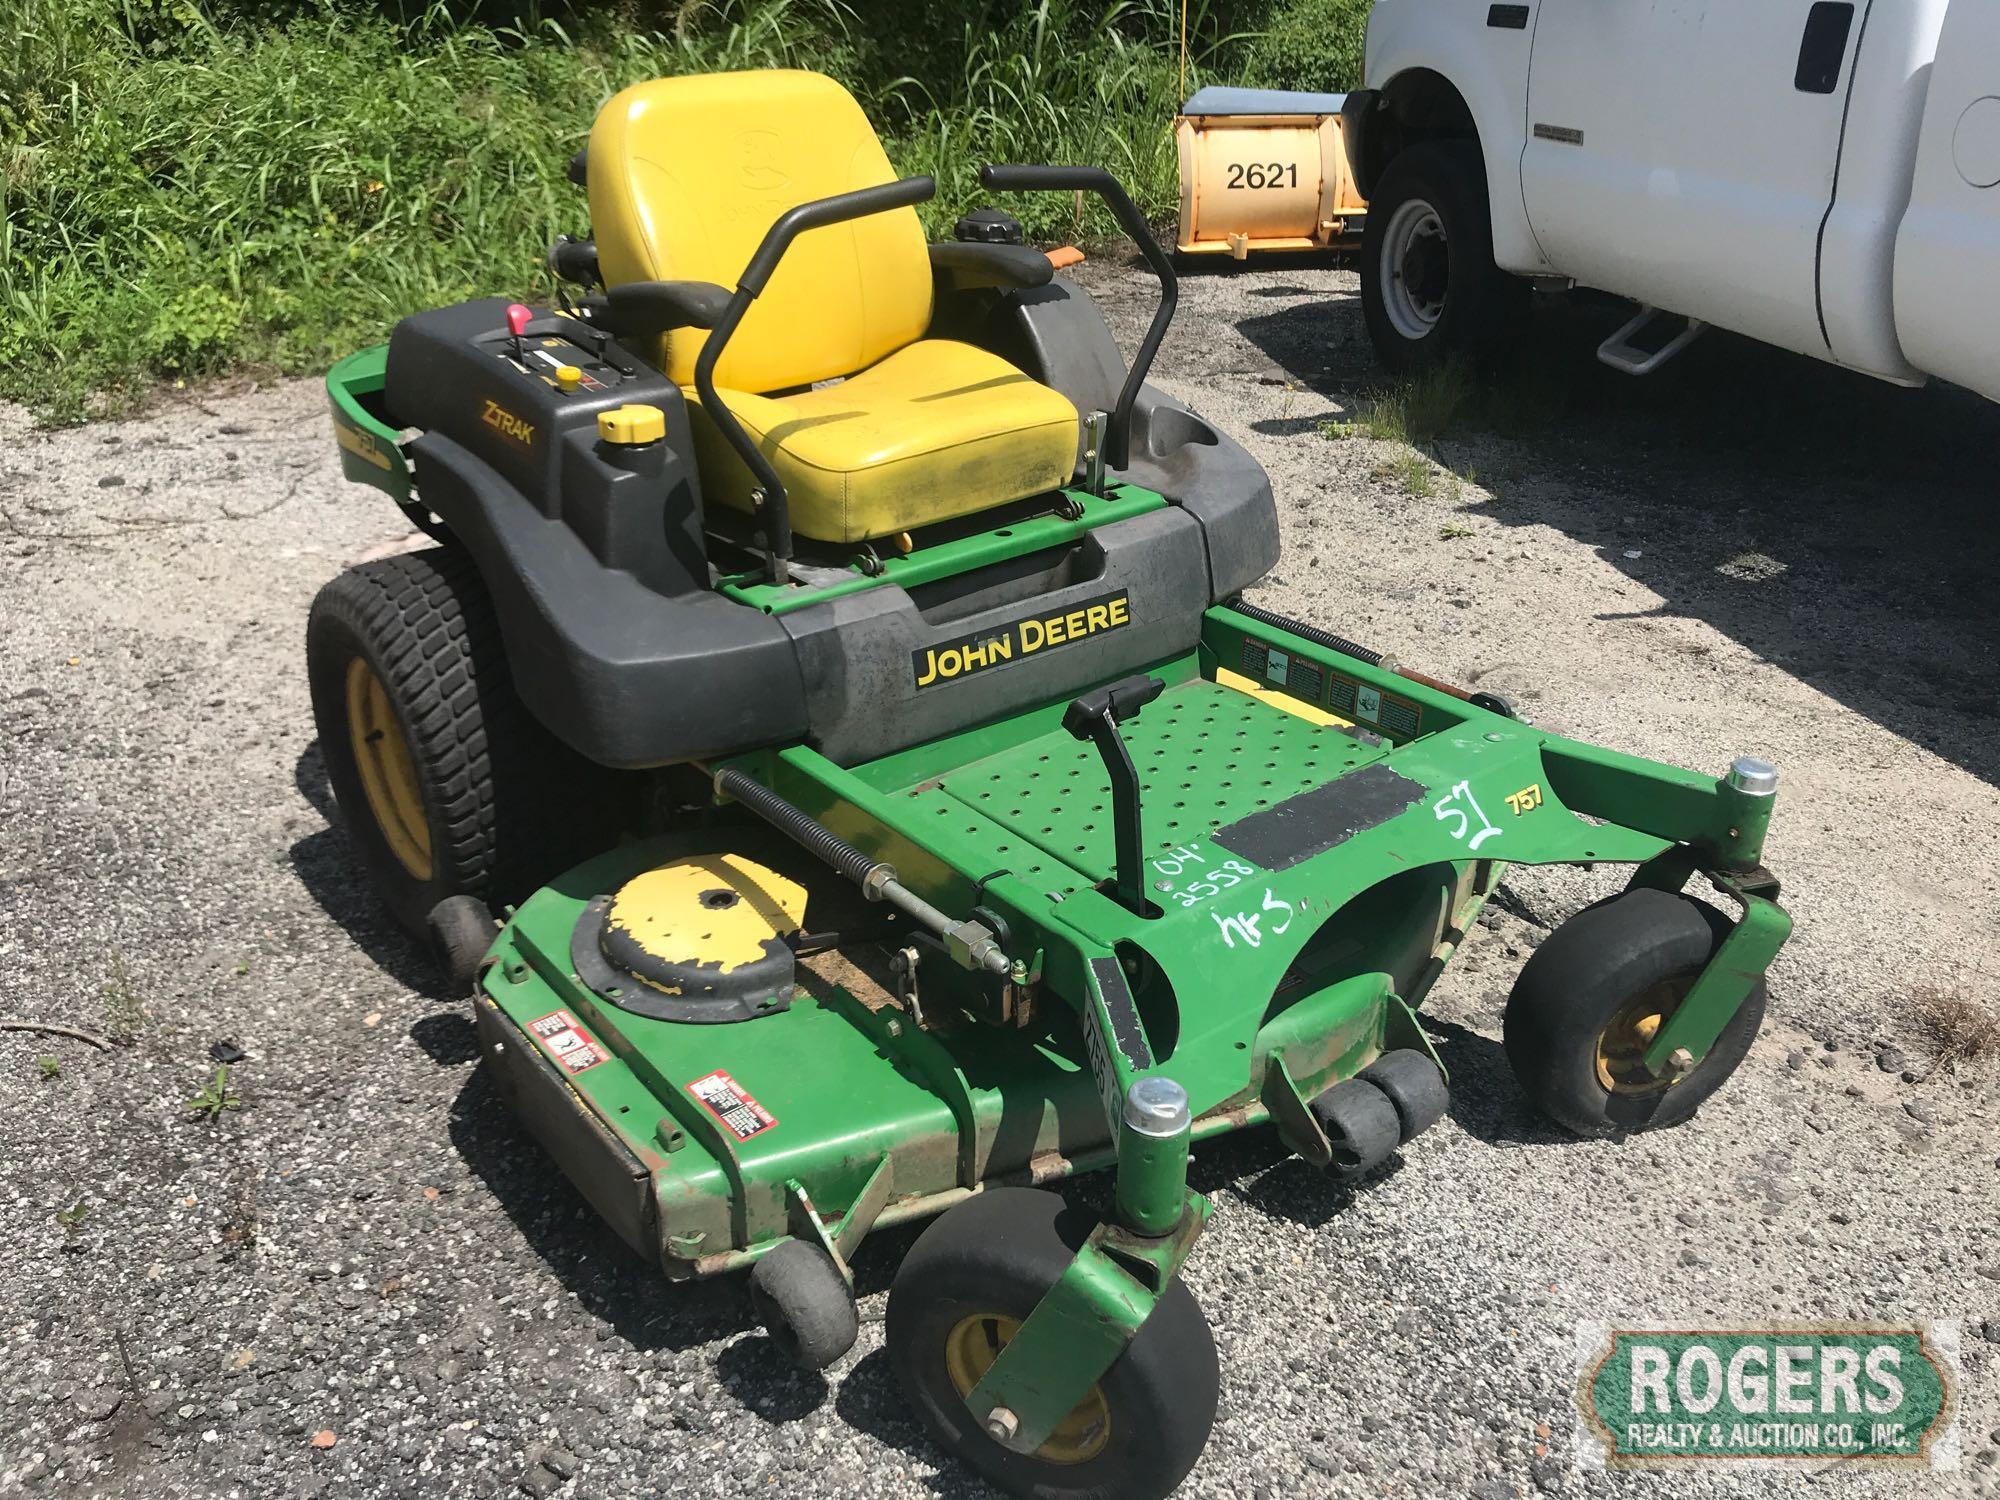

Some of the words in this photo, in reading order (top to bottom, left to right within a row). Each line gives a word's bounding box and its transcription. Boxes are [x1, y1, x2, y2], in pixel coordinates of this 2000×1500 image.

[1227, 163, 1297, 189] 2621
[1018, 597, 1129, 654] DEERE
[1504, 783, 1543, 816] 757
[1172, 860, 1254, 907] 2558
